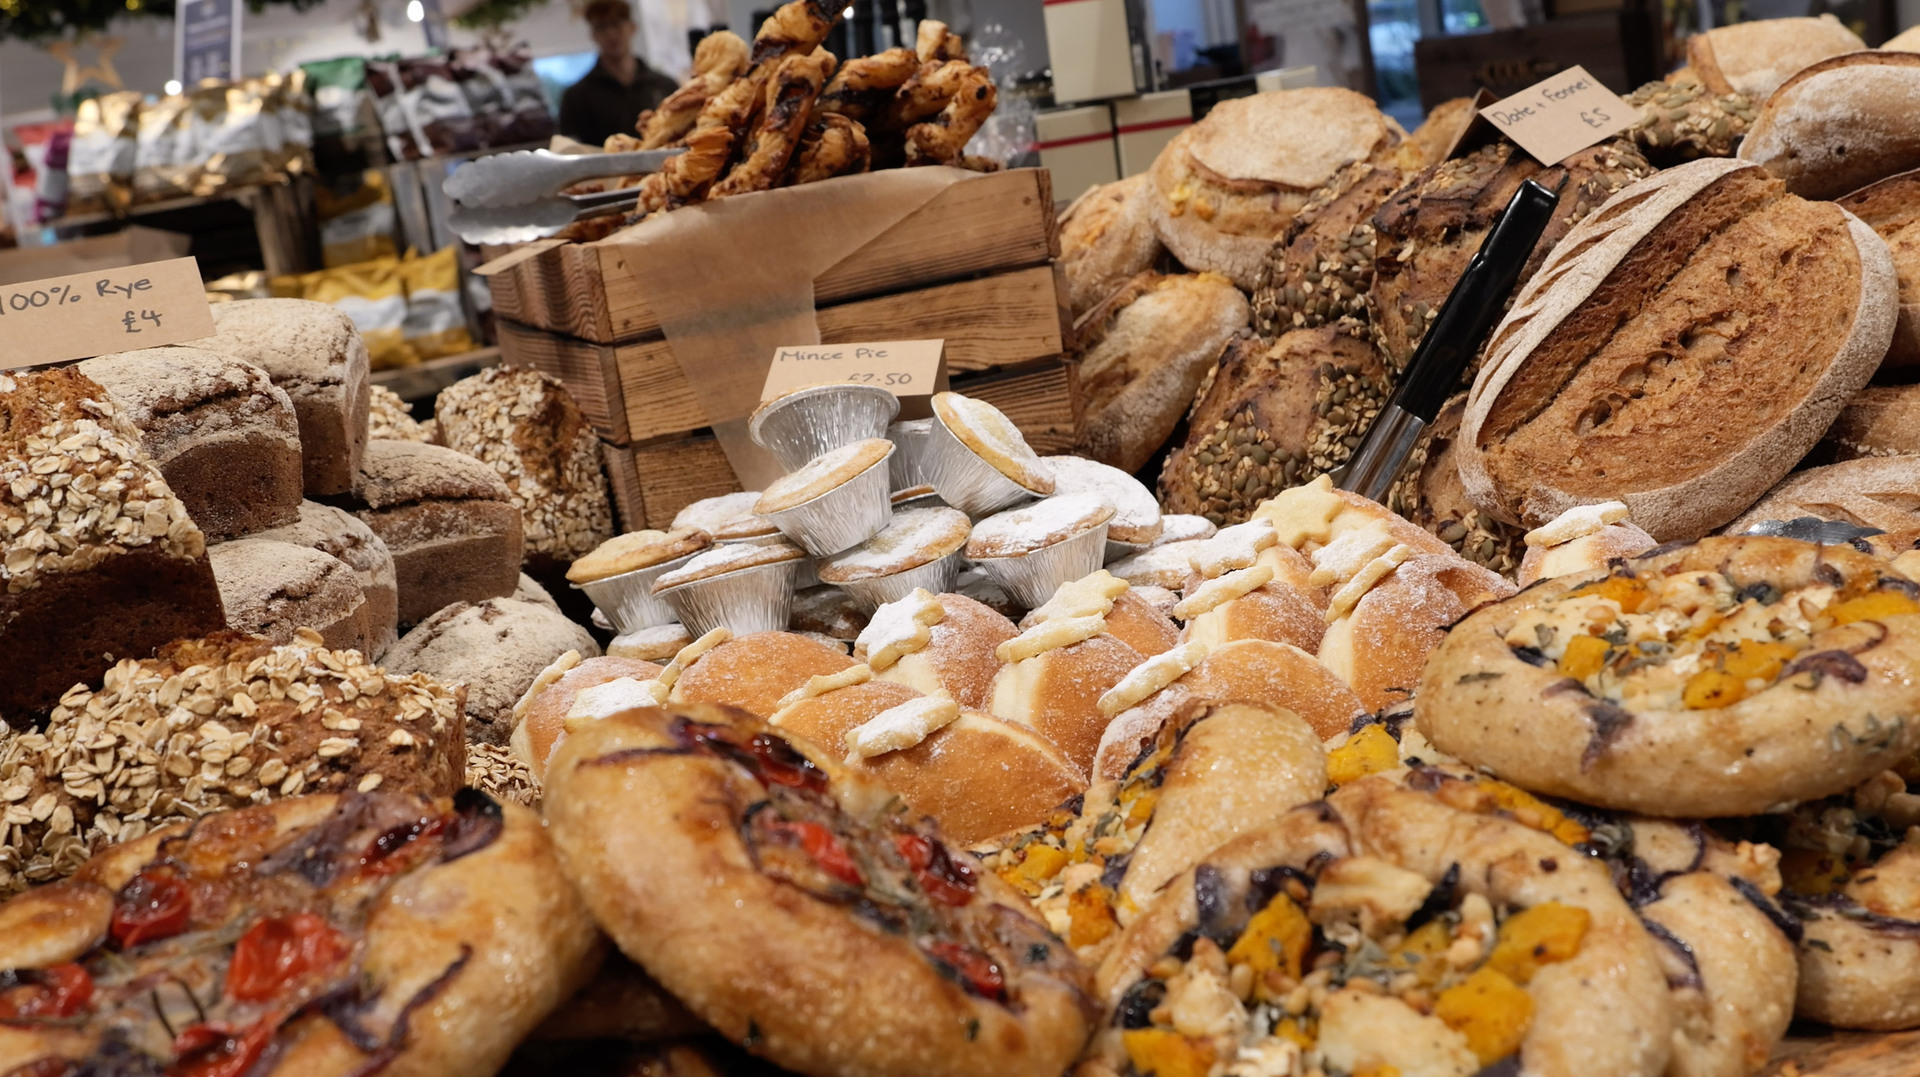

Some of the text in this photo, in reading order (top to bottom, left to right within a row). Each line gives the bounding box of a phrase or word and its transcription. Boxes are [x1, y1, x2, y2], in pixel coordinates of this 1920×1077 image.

[1492, 105, 1536, 126] Date
[1580, 107, 1611, 128] £5
[0, 278, 153, 315] 100% Rye
[121, 309, 163, 333] £4
[780, 347, 889, 362] Mince Pie
